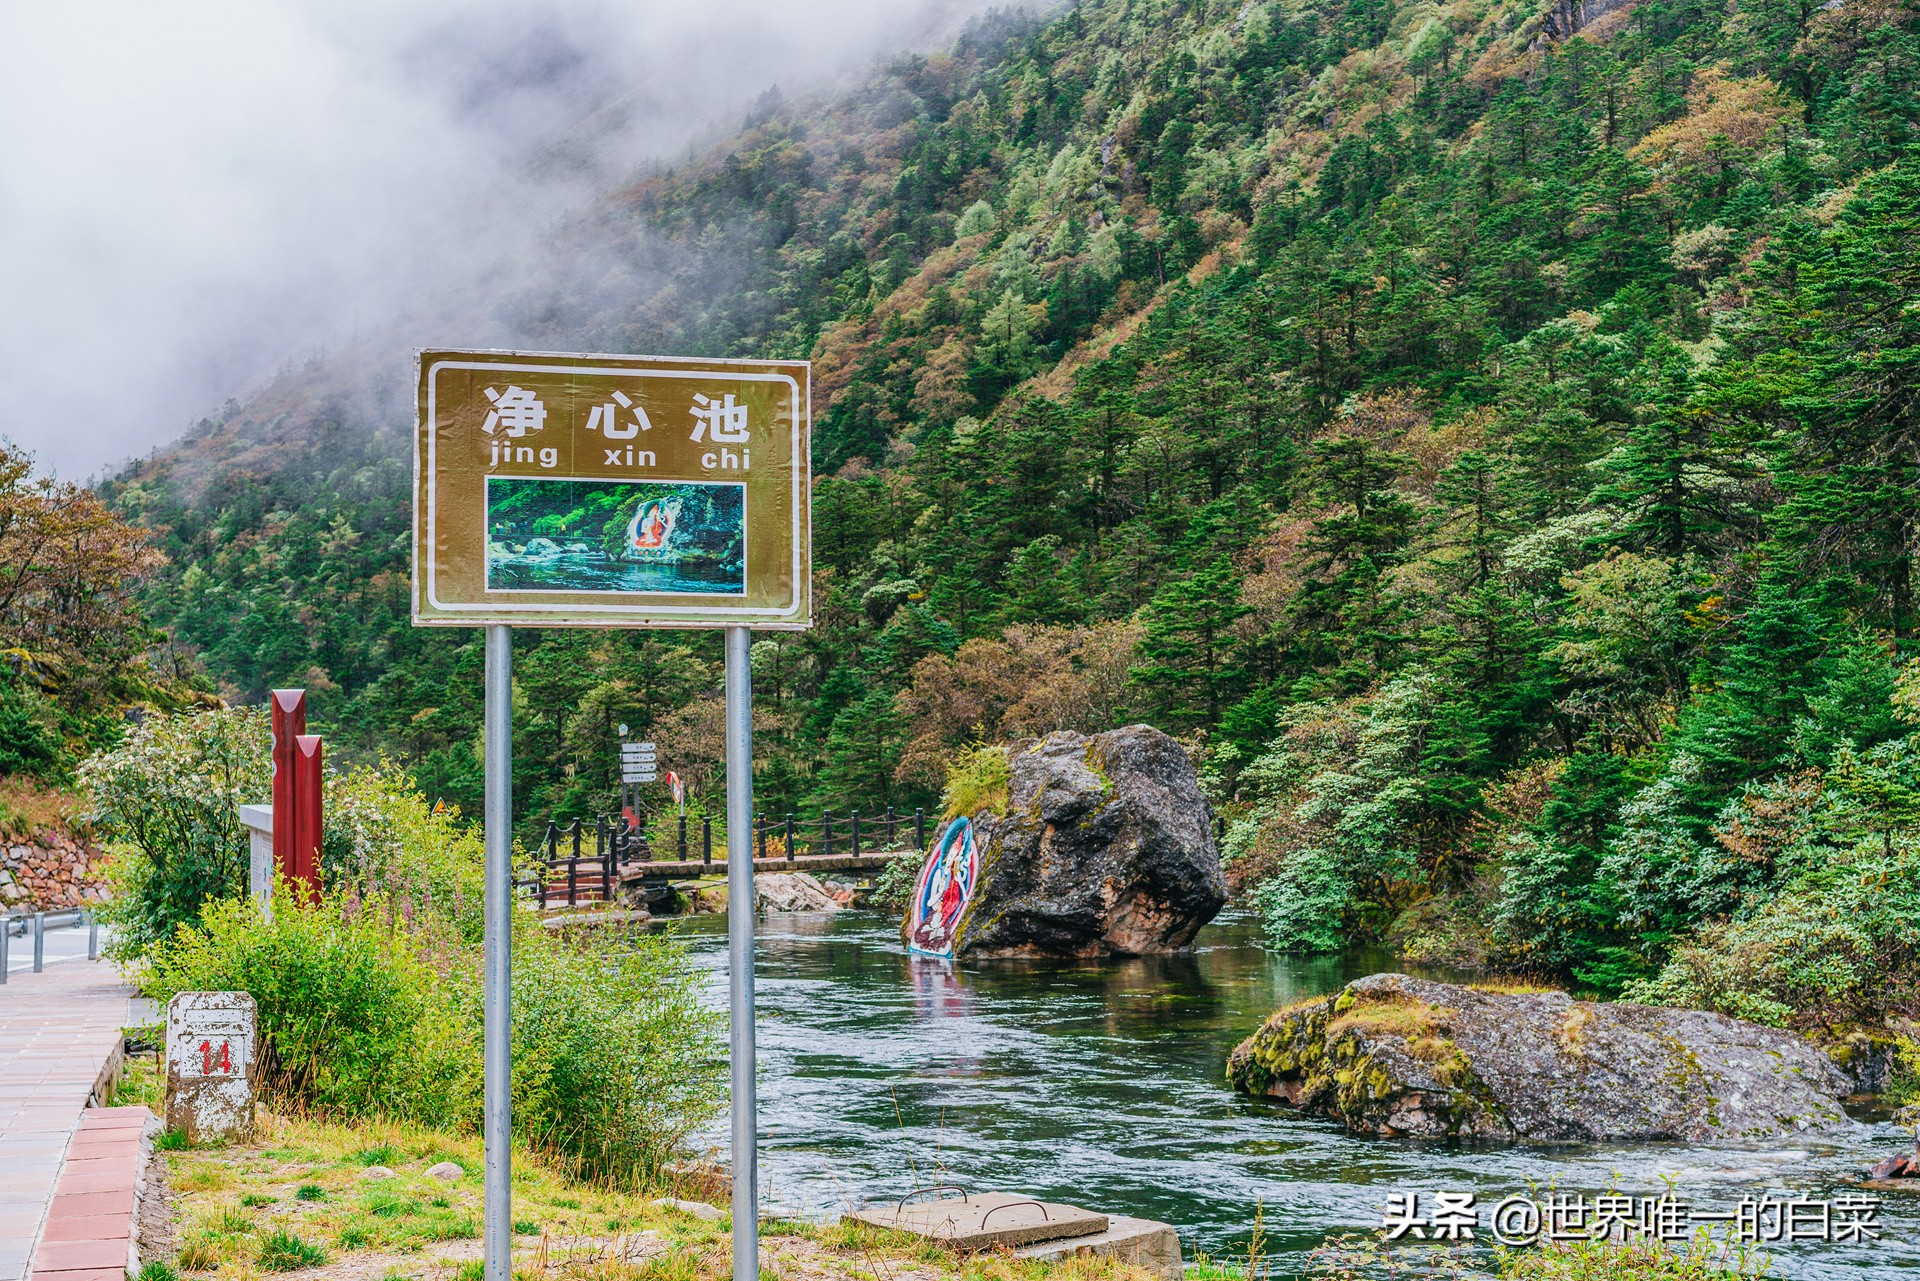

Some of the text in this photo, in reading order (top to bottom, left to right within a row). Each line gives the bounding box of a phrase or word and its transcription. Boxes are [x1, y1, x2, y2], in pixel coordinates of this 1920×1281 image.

[481, 385, 750, 443] 净心池
[489, 440, 751, 470] jing xin chi
[199, 1040, 231, 1075] 14
